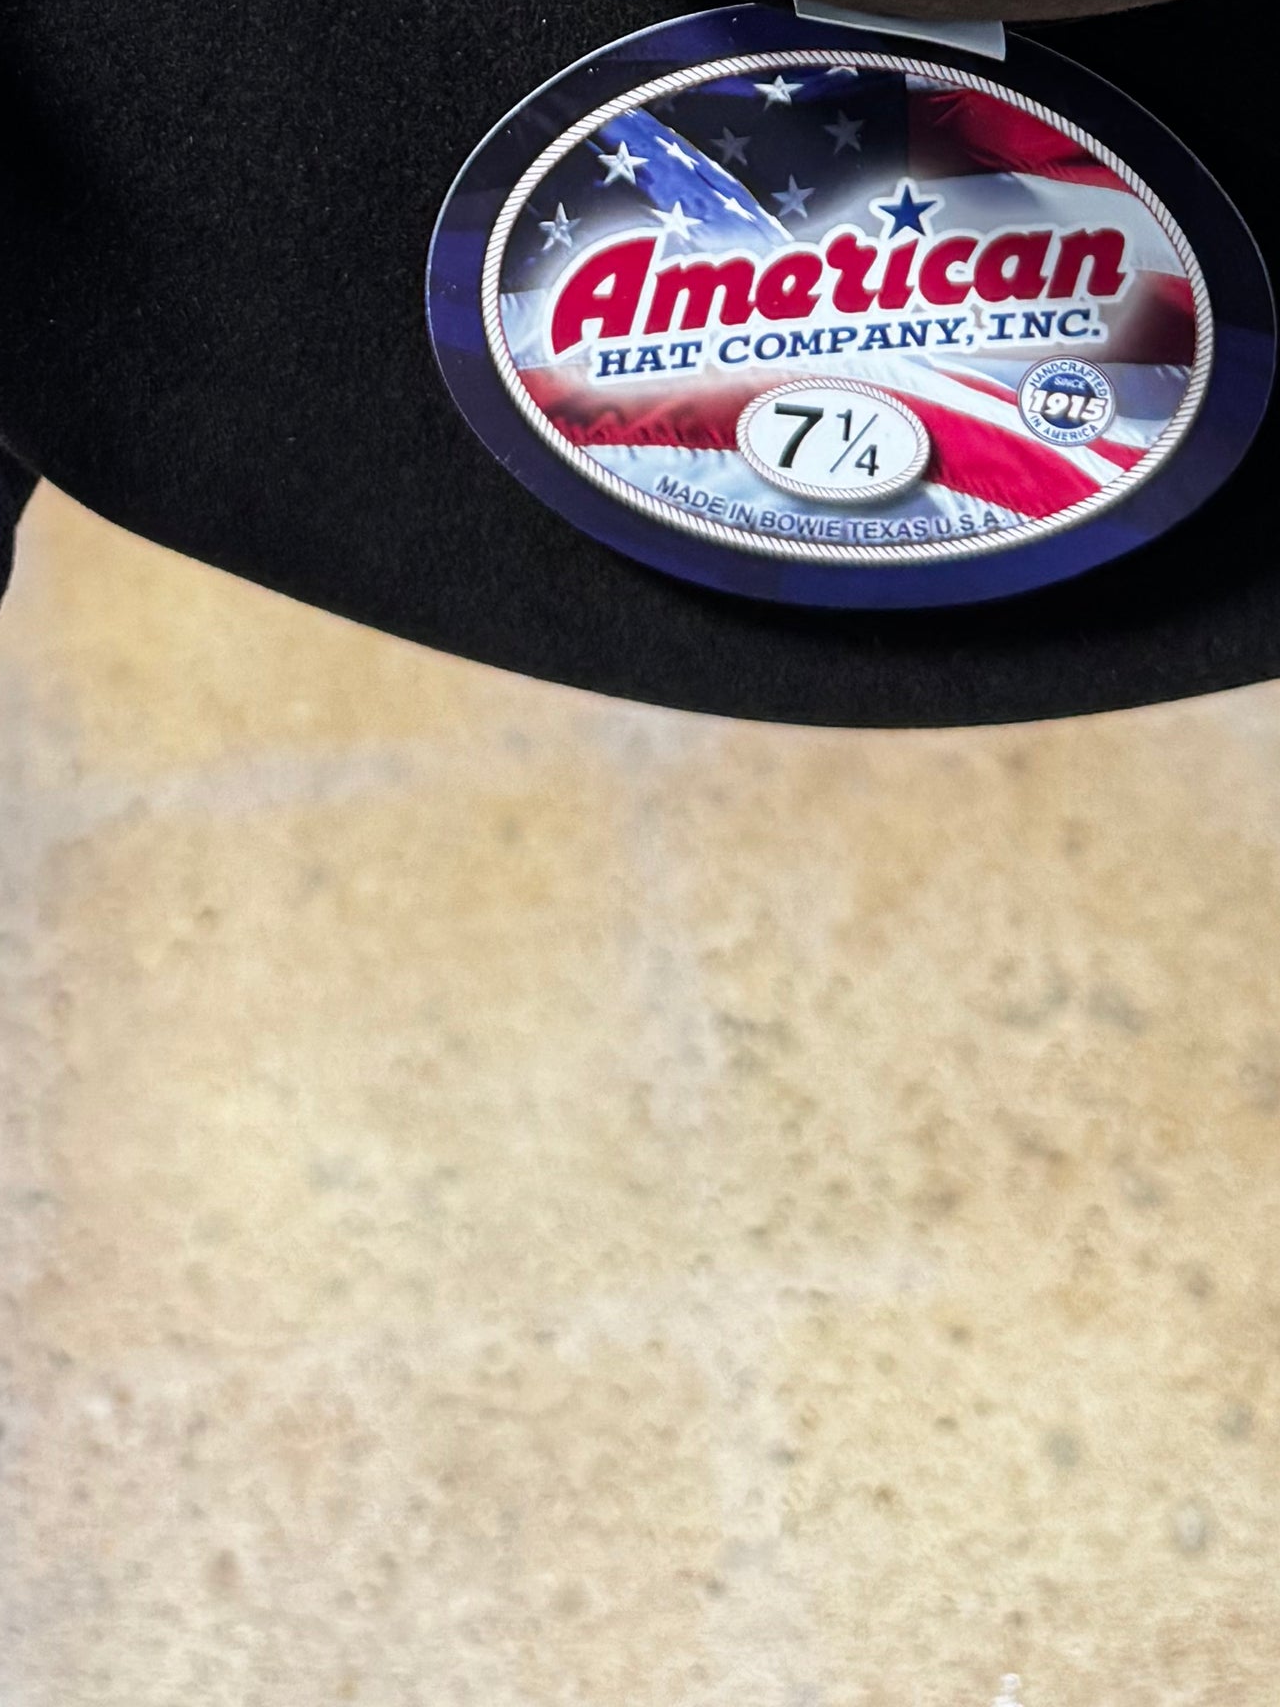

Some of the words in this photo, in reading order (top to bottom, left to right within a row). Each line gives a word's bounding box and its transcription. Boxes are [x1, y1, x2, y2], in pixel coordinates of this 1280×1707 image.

[551, 227, 1127, 355] American
[596, 340, 702, 377] HAT
[719, 316, 975, 364] COMPANY,
[986, 309, 1100, 341] INC.
[1028, 388, 1108, 421] 1915
[1029, 361, 1108, 396] HANDCRAFTED
[774, 402, 824, 469] 7
[1030, 415, 1042, 428] IN
[1043, 424, 1099, 440] AMERICA
[656, 475, 726, 515] MADE
[729, 502, 754, 524] IN
[760, 509, 841, 537] BOWIE
[847, 519, 928, 539] TEXAS
[934, 510, 1007, 536] U.S.A.
